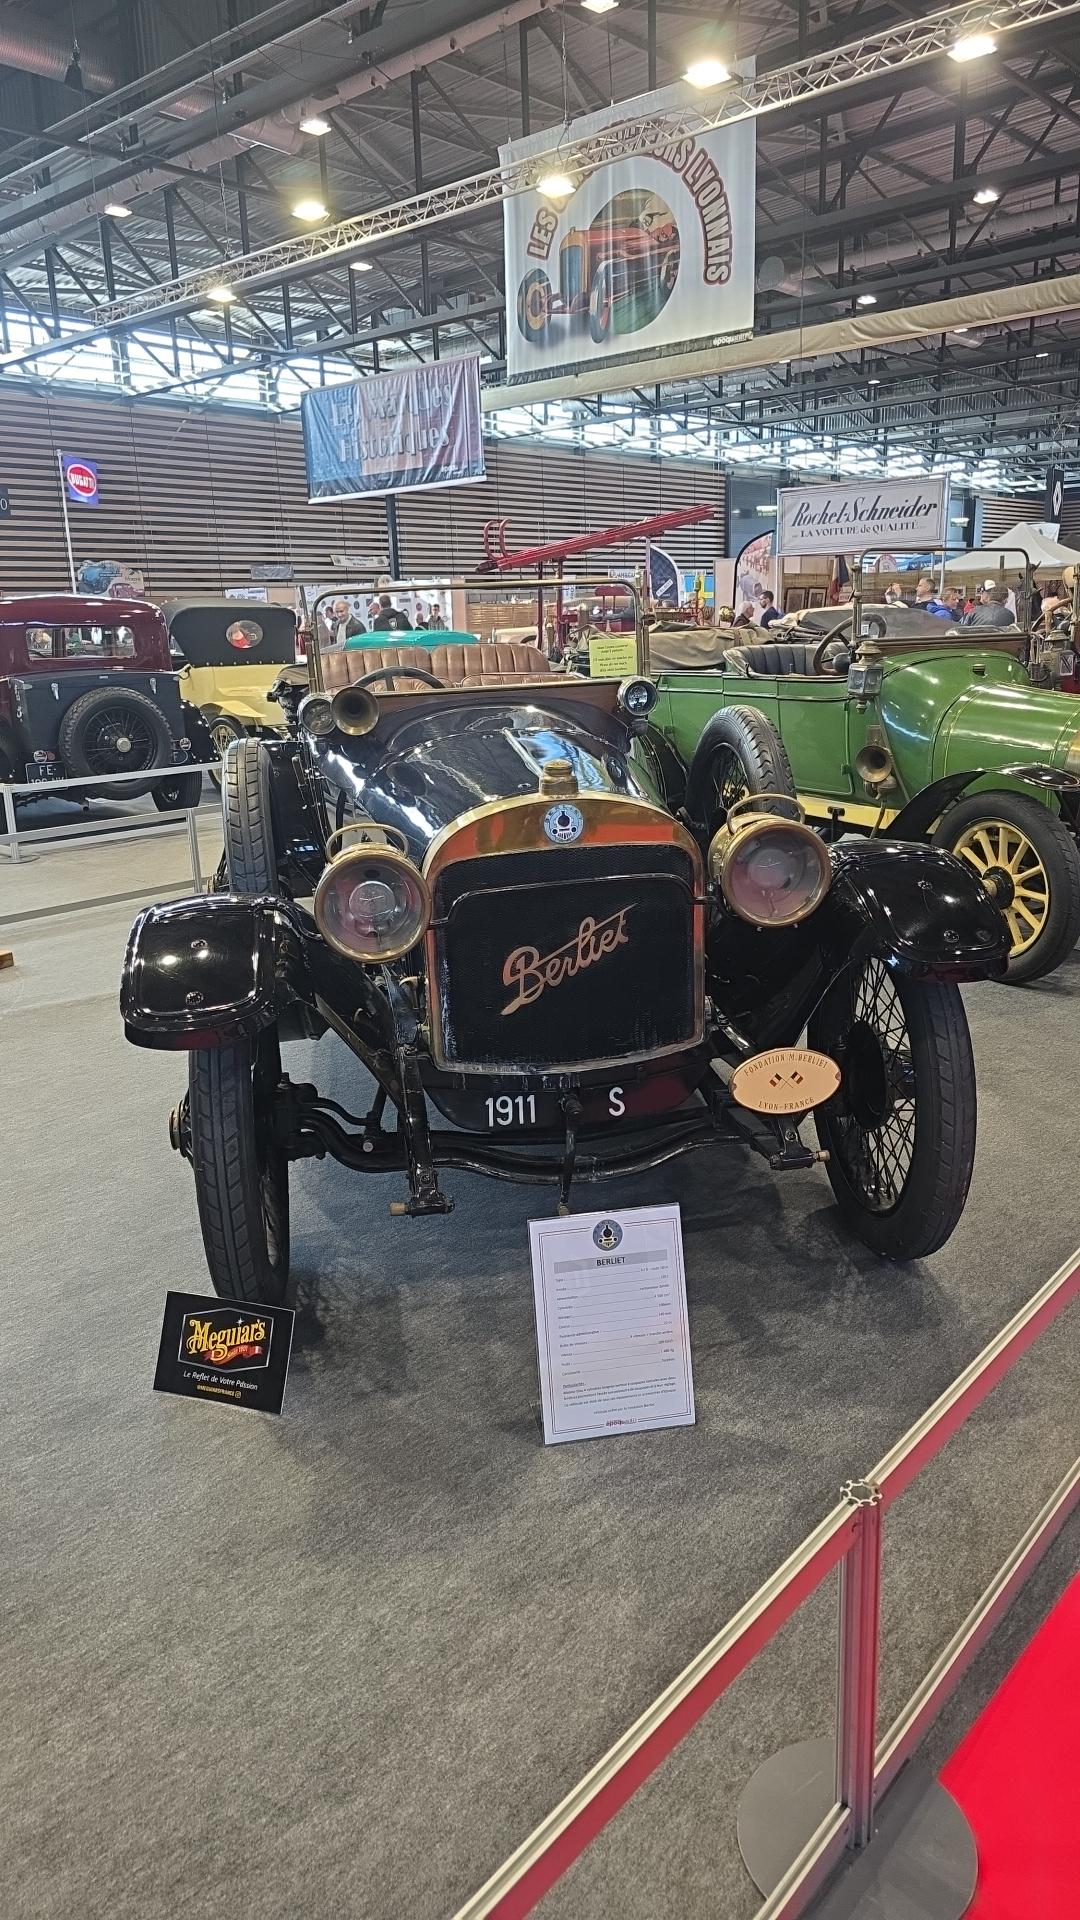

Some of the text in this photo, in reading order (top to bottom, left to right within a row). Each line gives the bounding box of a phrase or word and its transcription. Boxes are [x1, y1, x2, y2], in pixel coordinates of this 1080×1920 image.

[528, 207, 558, 260] LES
[683, 148, 733, 285] LYONNAIS
[800, 529, 813, 538] LA
[815, 526, 860, 537] VOITURE
[860, 524, 871, 533] de
[500, 903, 638, 1016] Berliet
[744, 1053, 785, 1077] FONDATION
[485, 1087, 626, 1127] 1911 S
[596, 1256, 626, 1267] BERLIET
[186, 1319, 266, 1361] Meguiar's
[183, 1370, 258, 1391] Le Reflet de Votre Passion
